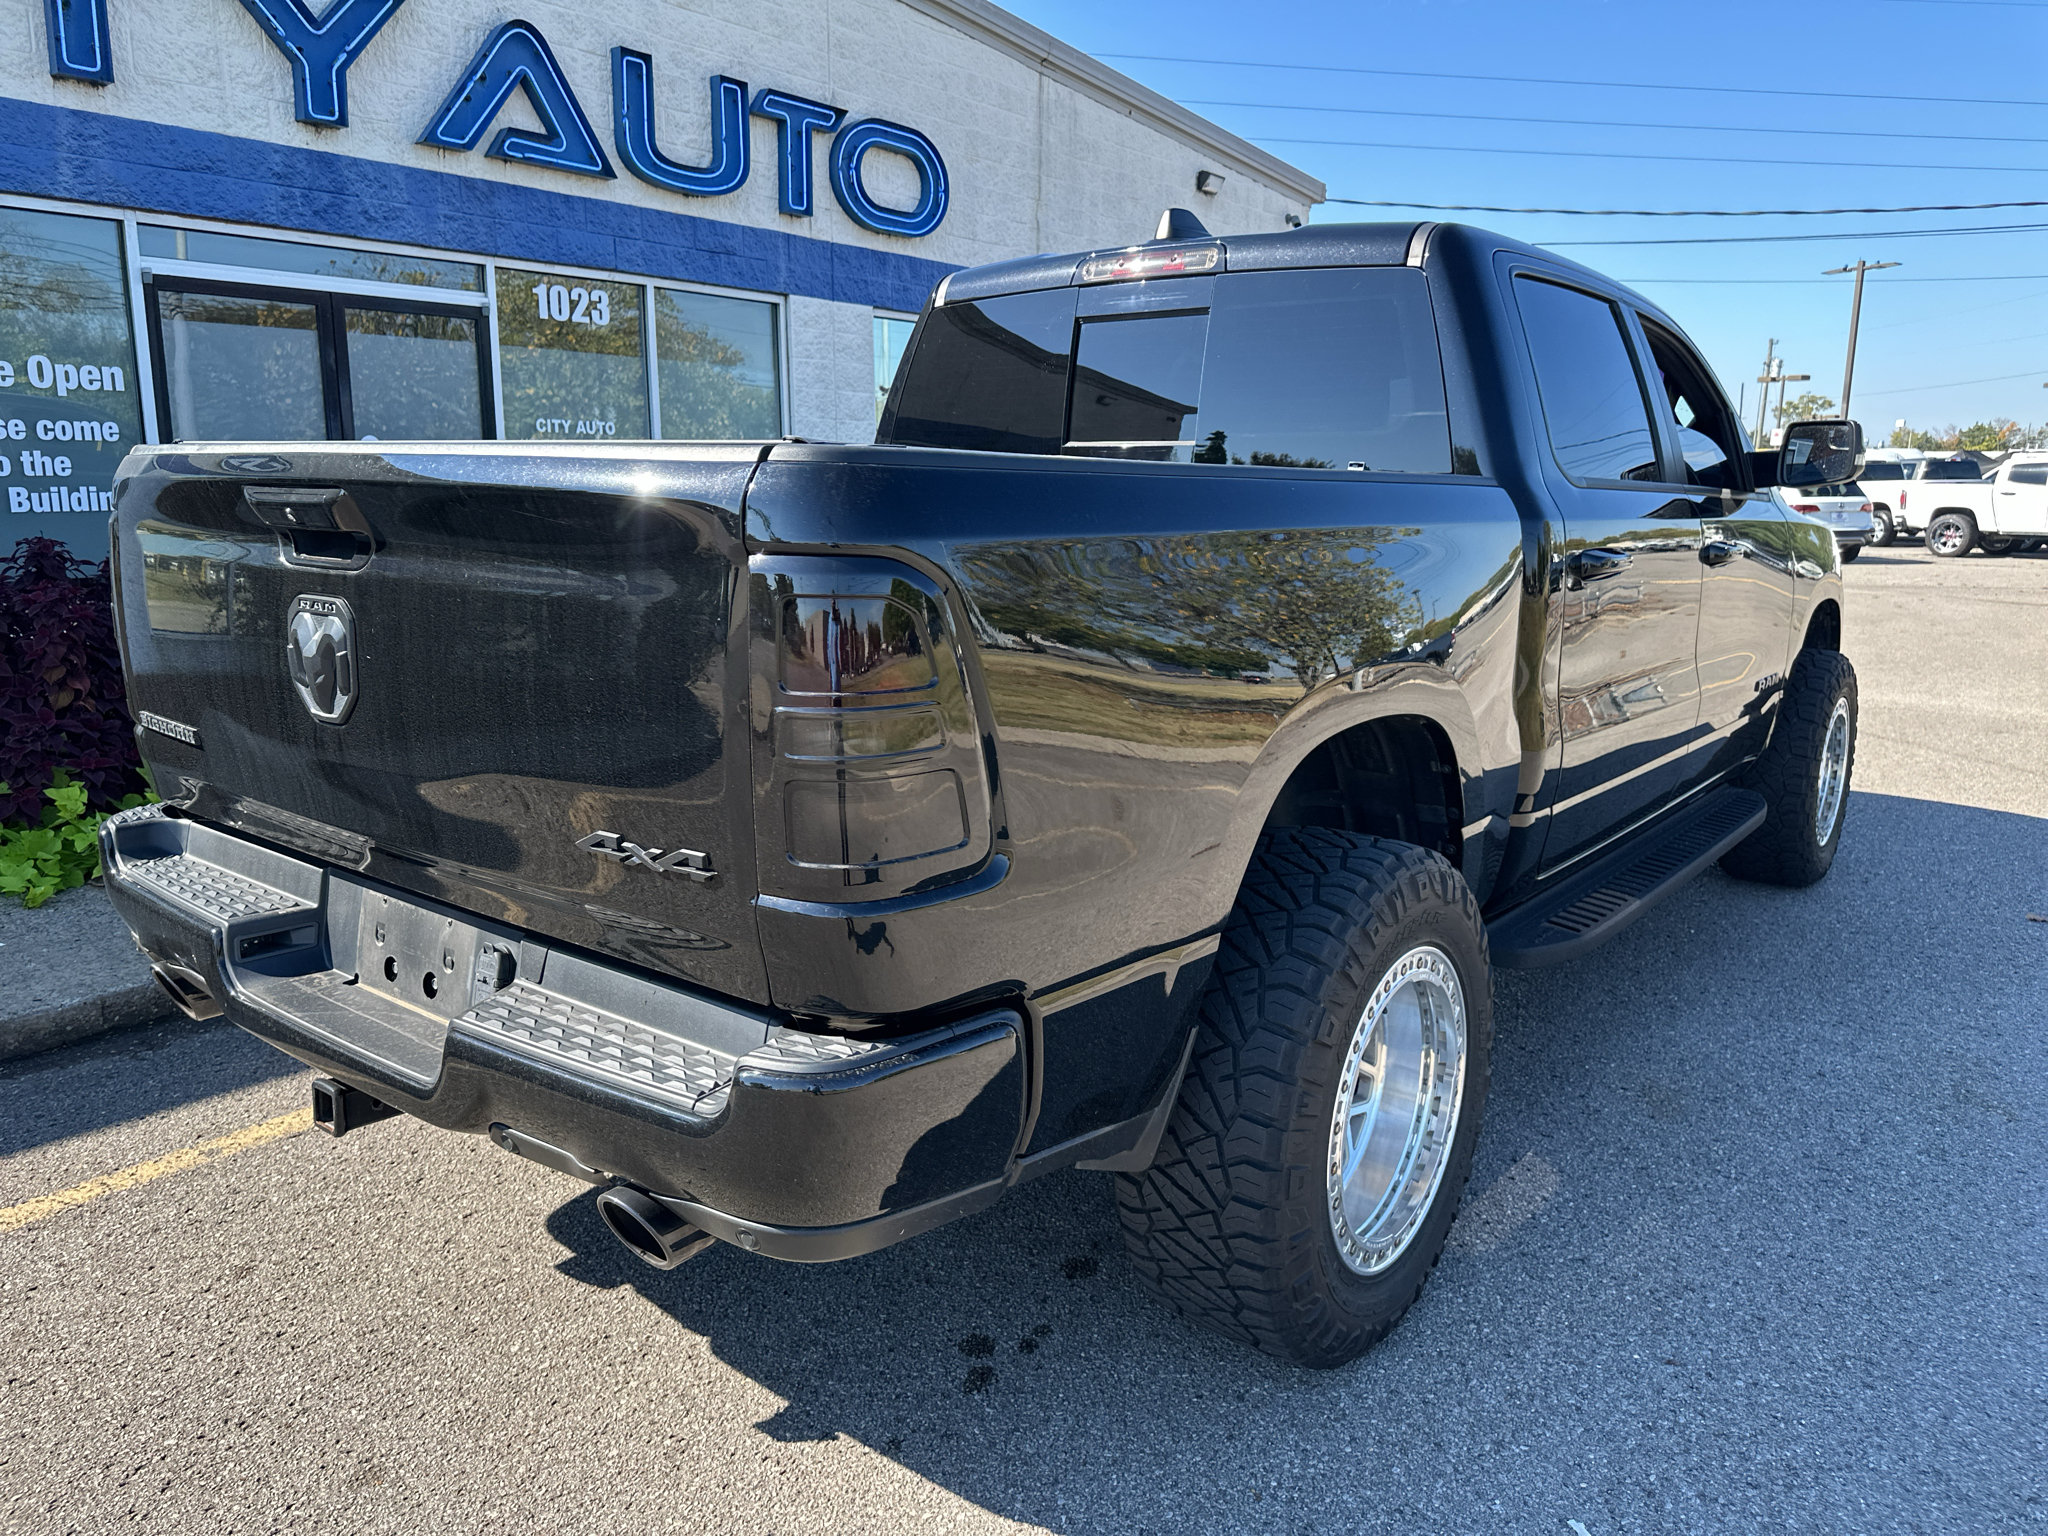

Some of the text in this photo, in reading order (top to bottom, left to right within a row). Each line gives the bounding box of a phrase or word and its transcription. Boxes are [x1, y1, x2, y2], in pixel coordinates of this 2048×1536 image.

[415, 19, 950, 238] AUTO
[532, 283, 611, 326] 1023
[27, 354, 125, 397] Open
[36, 419, 120, 442] come
[535, 417, 616, 436] CITY AUTO
[20, 450, 72, 477] the
[298, 599, 336, 613] RAM
[1757, 673, 1780, 691] RAM
